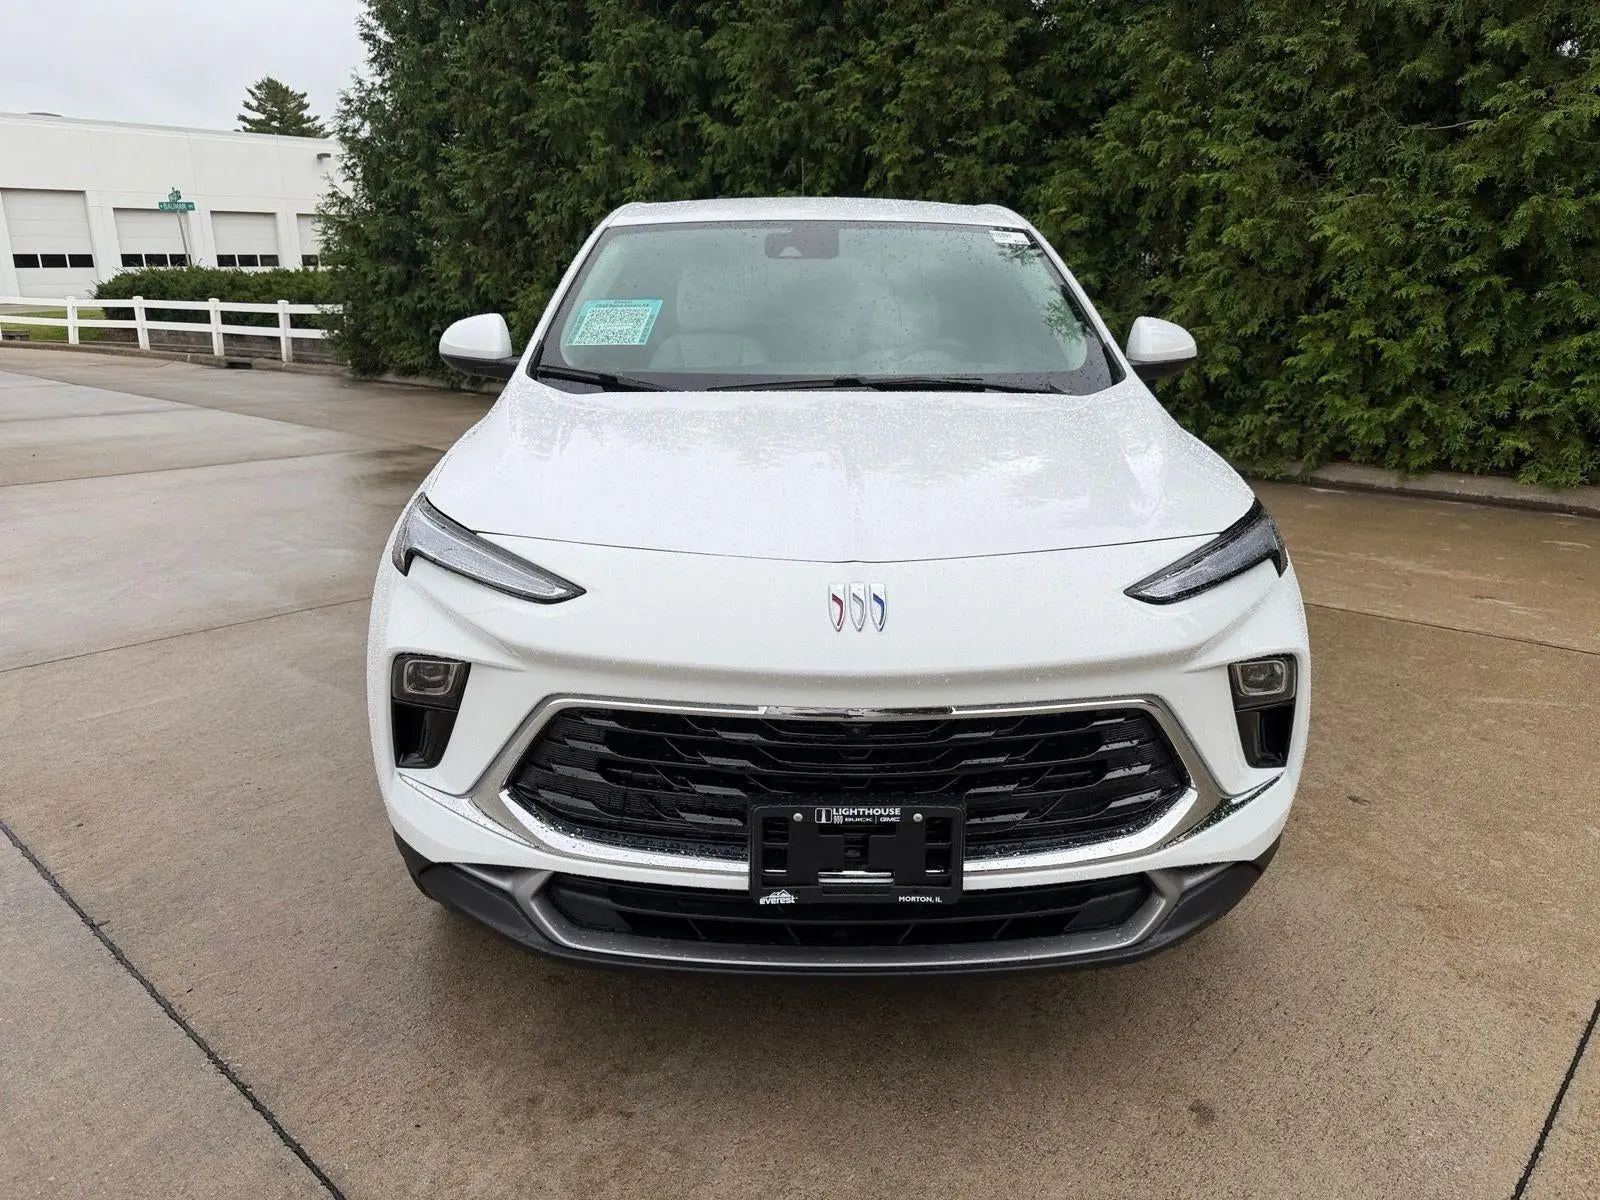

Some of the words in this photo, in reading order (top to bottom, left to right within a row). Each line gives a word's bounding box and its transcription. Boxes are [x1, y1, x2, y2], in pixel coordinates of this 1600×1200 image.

[163, 202, 187, 210] BAUMAN
[760, 895, 796, 904] everest
[898, 895, 934, 903] MORTON,
